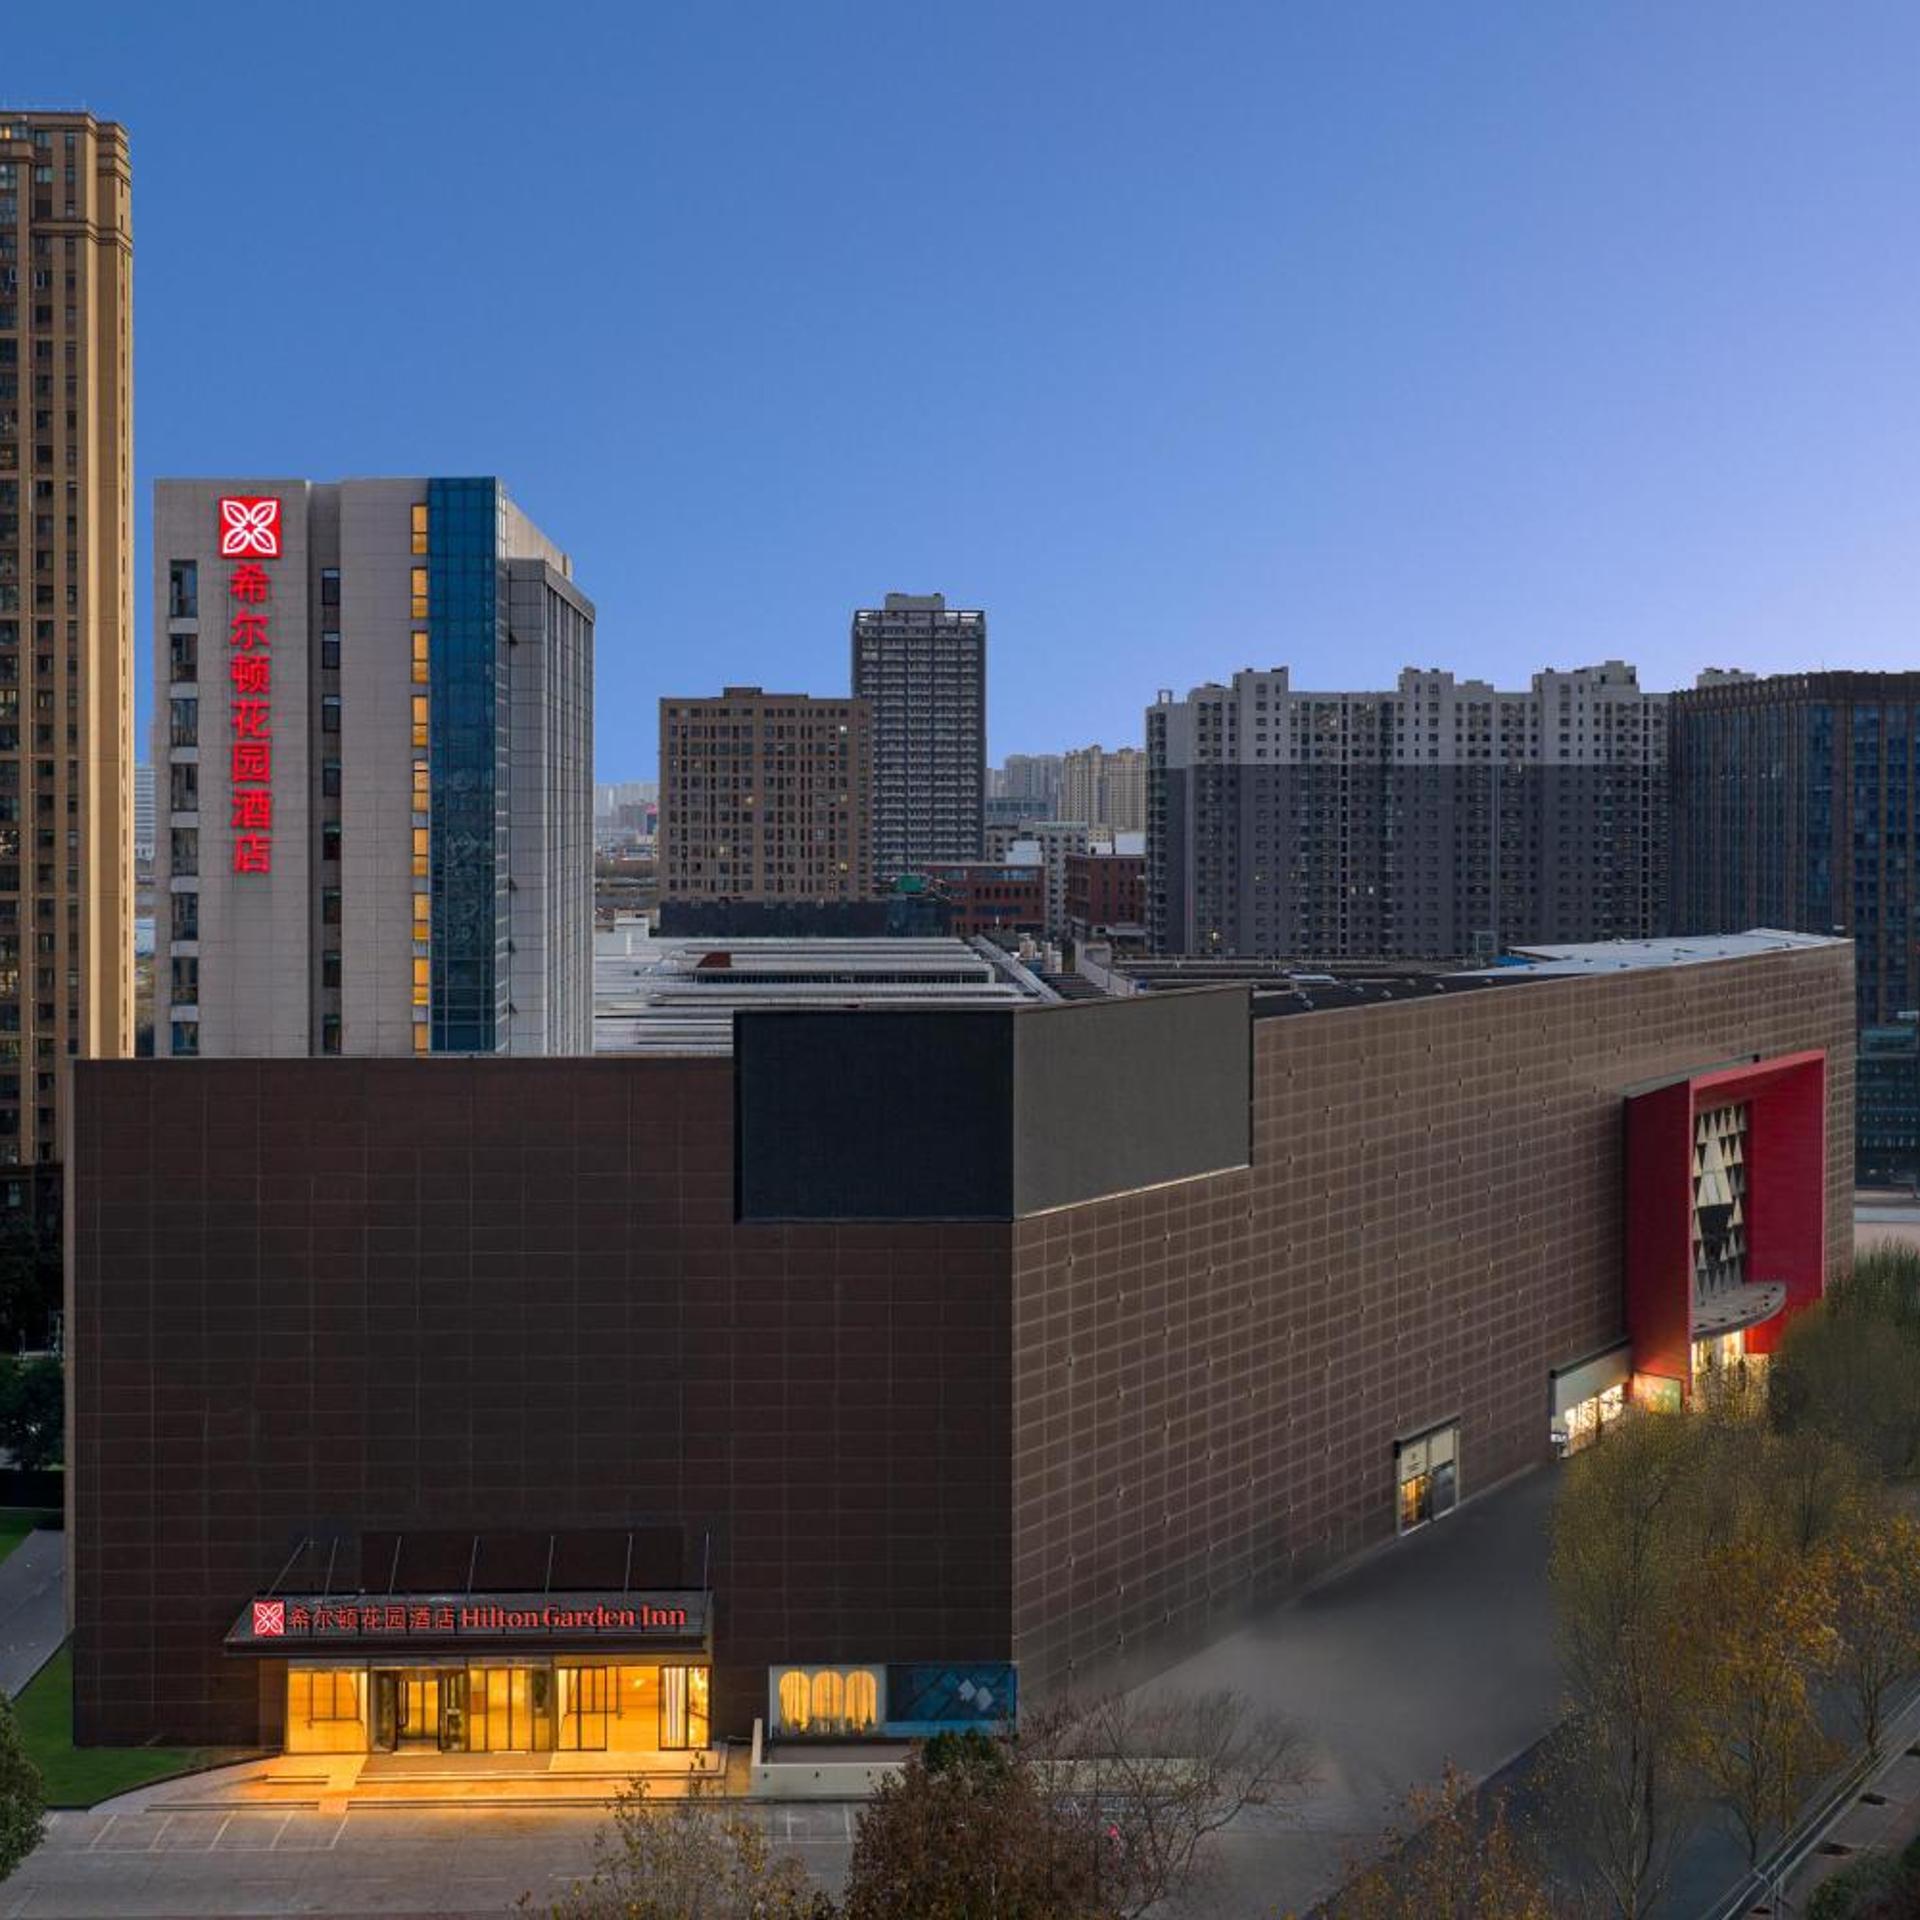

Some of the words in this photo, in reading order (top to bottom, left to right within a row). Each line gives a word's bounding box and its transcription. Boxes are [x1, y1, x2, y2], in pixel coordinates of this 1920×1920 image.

[230, 563, 271, 872] 希尔顿花园酒店
[288, 1605, 455, 1630] 希尔顿花园酒店
[461, 1606, 538, 1628] Hilton
[543, 1606, 635, 1628] Garden
[641, 1605, 686, 1626] Inn
